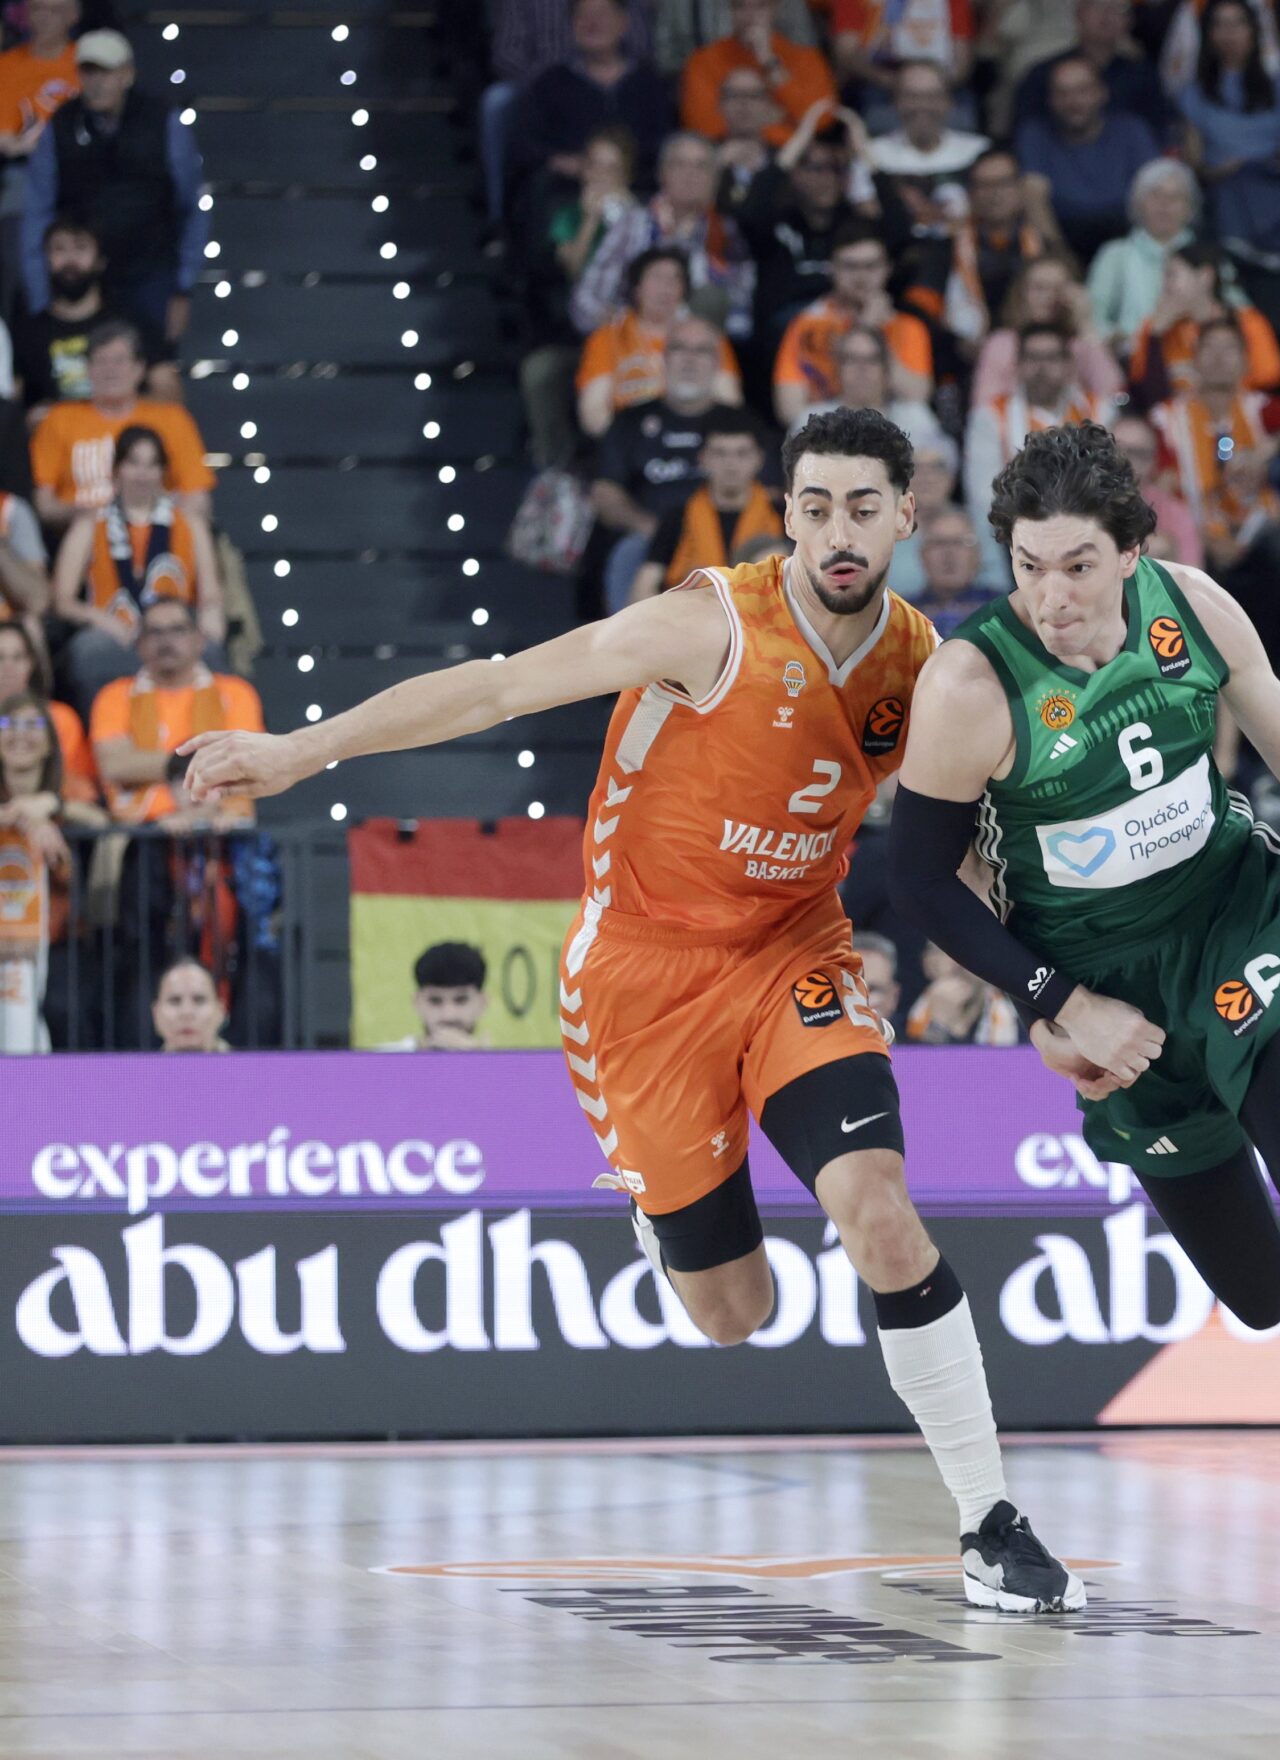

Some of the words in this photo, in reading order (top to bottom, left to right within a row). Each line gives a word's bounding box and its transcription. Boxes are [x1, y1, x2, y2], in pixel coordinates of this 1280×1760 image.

[788, 758, 842, 814] 2
[1118, 721, 1164, 791] 6
[1124, 799, 1190, 838] Ομάδα
[744, 860, 811, 880] BASKET
[14, 1212, 347, 1357] abu
[497, 1585, 1004, 1666] PLAYOFFS
